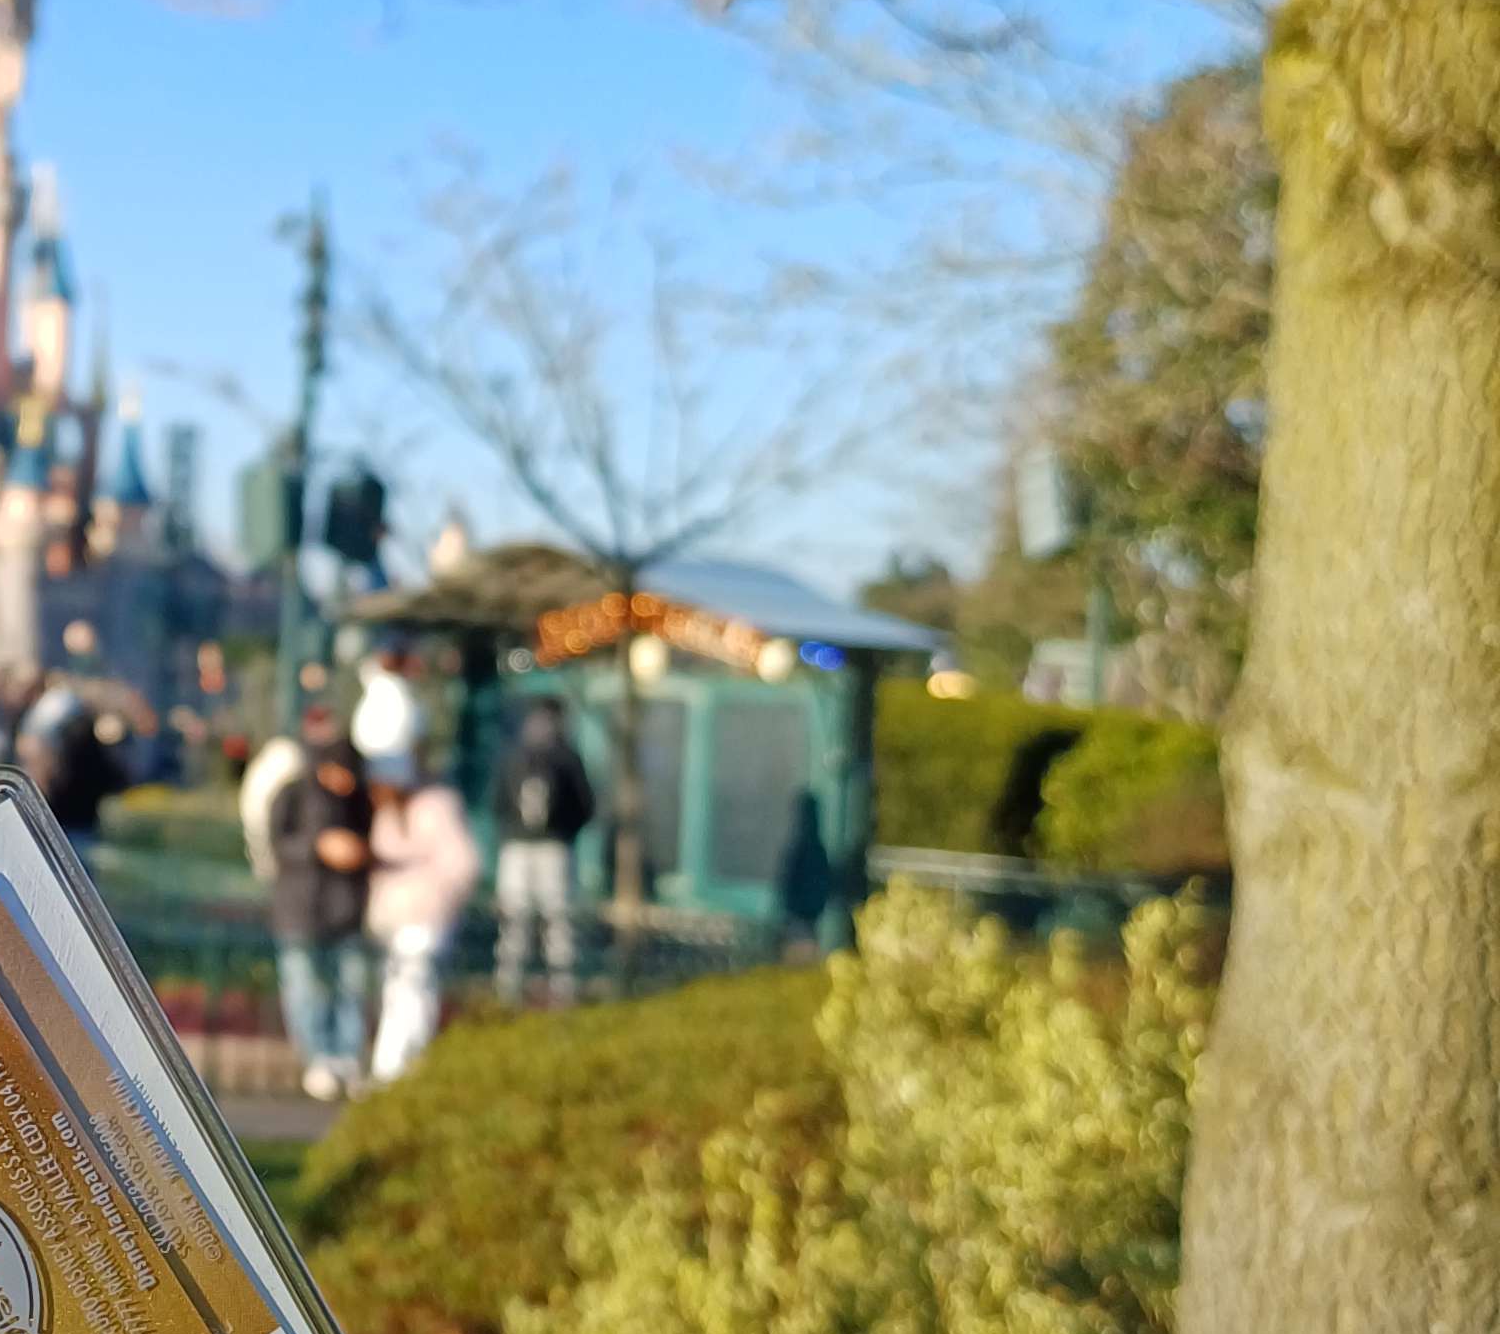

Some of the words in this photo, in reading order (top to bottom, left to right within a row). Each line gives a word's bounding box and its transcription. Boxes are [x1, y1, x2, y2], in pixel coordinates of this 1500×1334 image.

[7, 1104, 48, 1156] CEDEX
[50, 1112, 156, 1289] Disneylandparis.com
[148, 1220, 177, 1255] SKU
[44, 1235, 92, 1299] DISNEY
